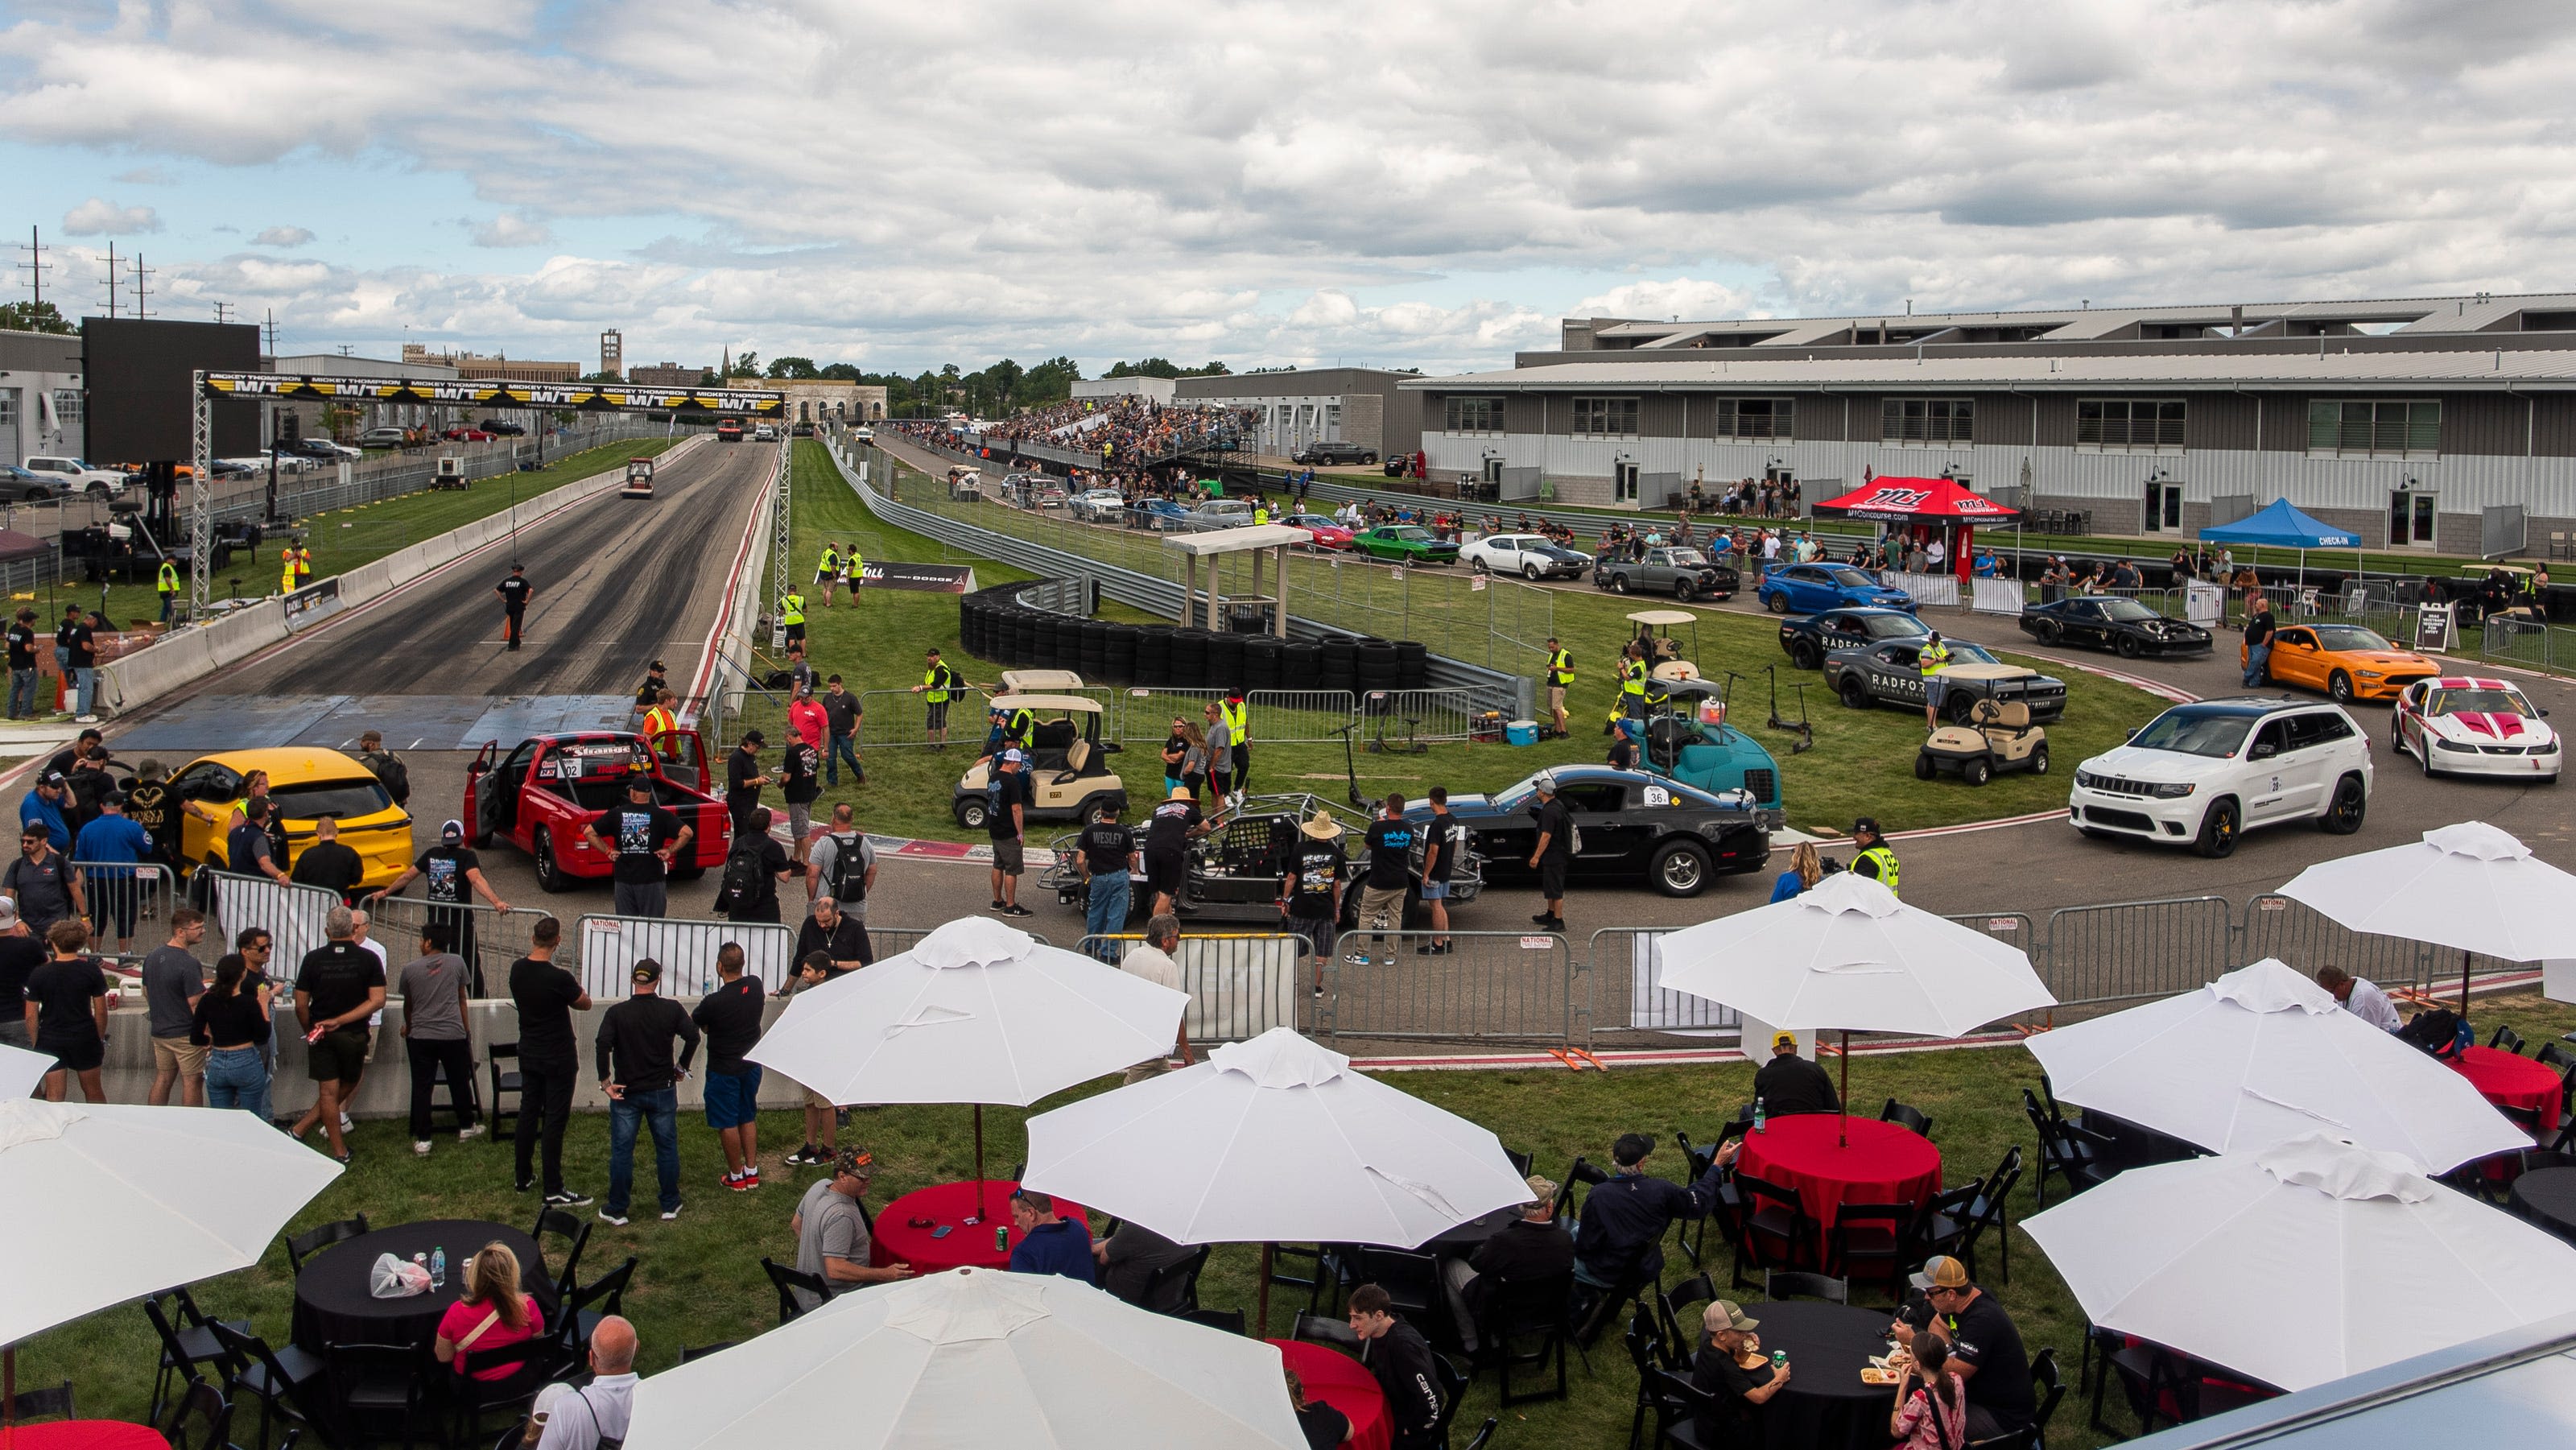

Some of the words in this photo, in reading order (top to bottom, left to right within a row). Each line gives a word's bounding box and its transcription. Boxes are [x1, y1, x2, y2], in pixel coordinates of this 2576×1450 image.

[235, 381, 283, 393] M/T
[336, 384, 382, 397] M/T
[435, 388, 481, 400] M/T
[531, 392, 576, 403] M/T
[625, 395, 669, 407] M/T
[718, 399, 762, 410] M/T
[1847, 510, 1908, 521] M1Concourse.com
[2319, 536, 2349, 546] CHECK-IN
[1872, 674, 1925, 693] RADFOR
[1651, 793, 1663, 803] 36
[131, 810, 157, 818] BORN
[1093, 832, 1123, 845] WESLEY
[1884, 854, 1899, 877] 92
[592, 919, 619, 928] NATIONAL
